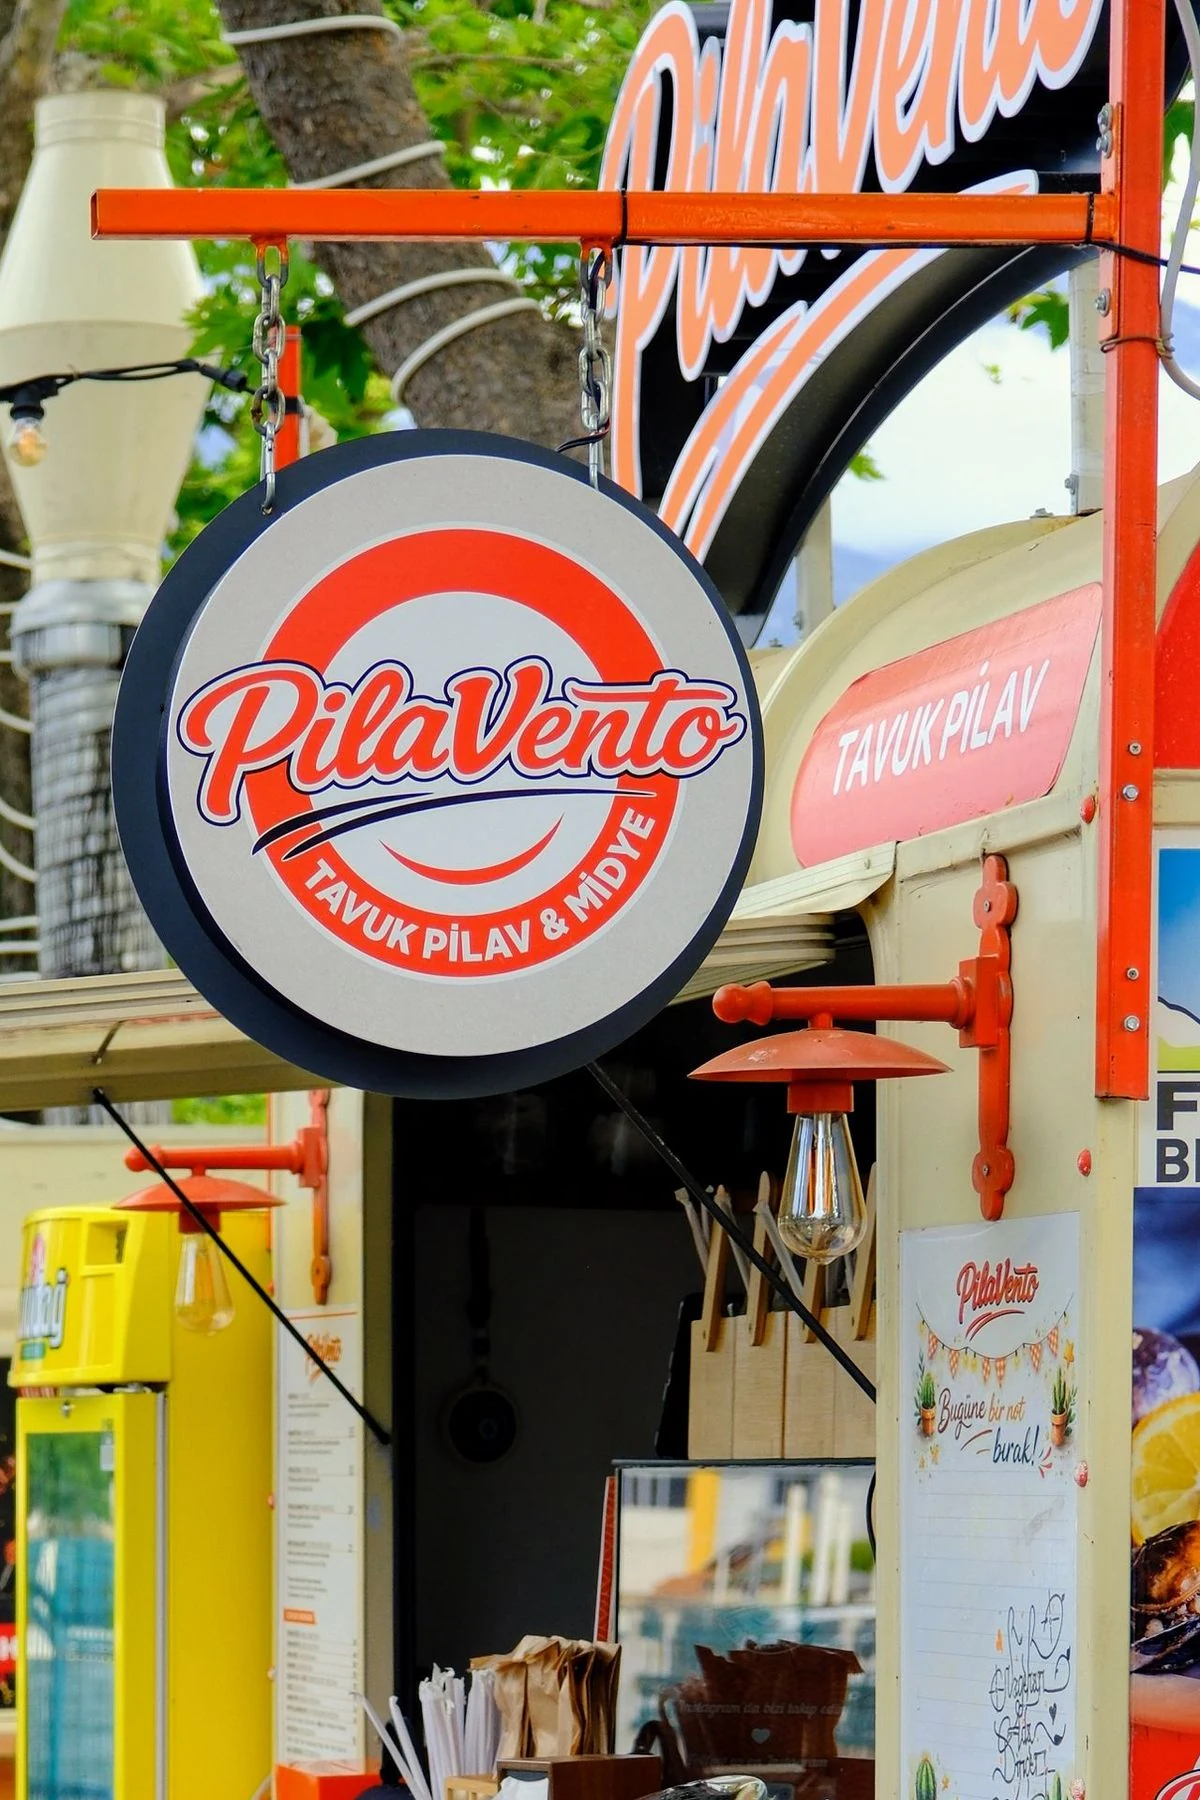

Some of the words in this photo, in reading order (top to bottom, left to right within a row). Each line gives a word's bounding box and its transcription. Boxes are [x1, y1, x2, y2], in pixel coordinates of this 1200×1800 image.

[178, 656, 745, 825] PilaVento
[832, 699, 944, 795] TAVUK
[939, 660, 1049, 760] PİLAV
[305, 859, 423, 957] TAVUK
[424, 920, 530, 963] PİLAV
[539, 908, 567, 941] &
[564, 807, 656, 923] MİDYE
[957, 1258, 1039, 1324] PilaVento
[938, 1388, 986, 1440] Bugüne
[988, 1393, 1004, 1422] bir
[1005, 1396, 1025, 1422] not
